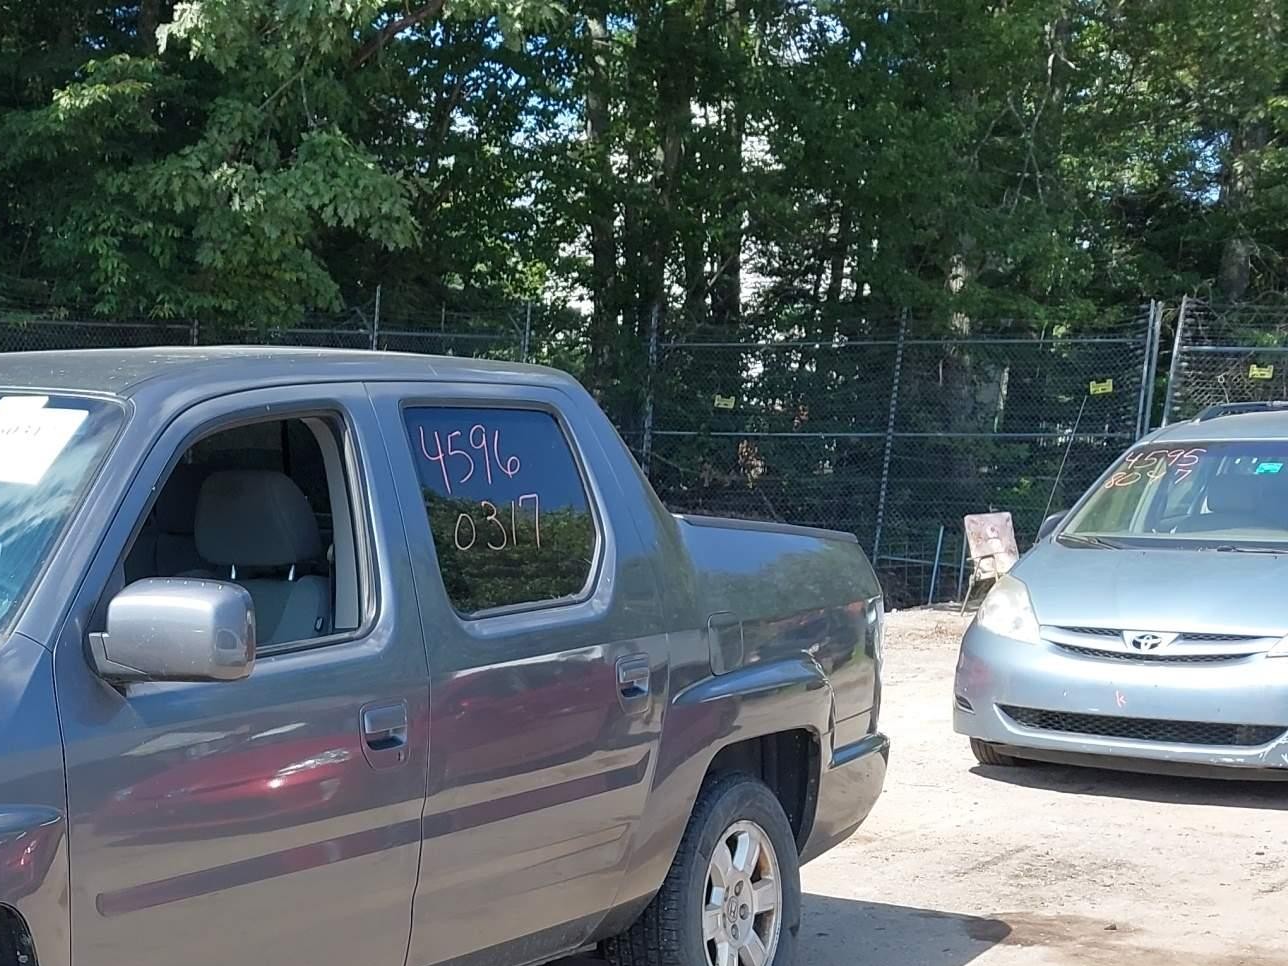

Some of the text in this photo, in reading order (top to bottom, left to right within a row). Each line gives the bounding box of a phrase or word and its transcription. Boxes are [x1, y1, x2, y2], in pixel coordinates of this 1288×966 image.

[419, 424, 521, 495] 4596
[1125, 448, 1207, 470] 4595
[454, 493, 541, 551] 0317
